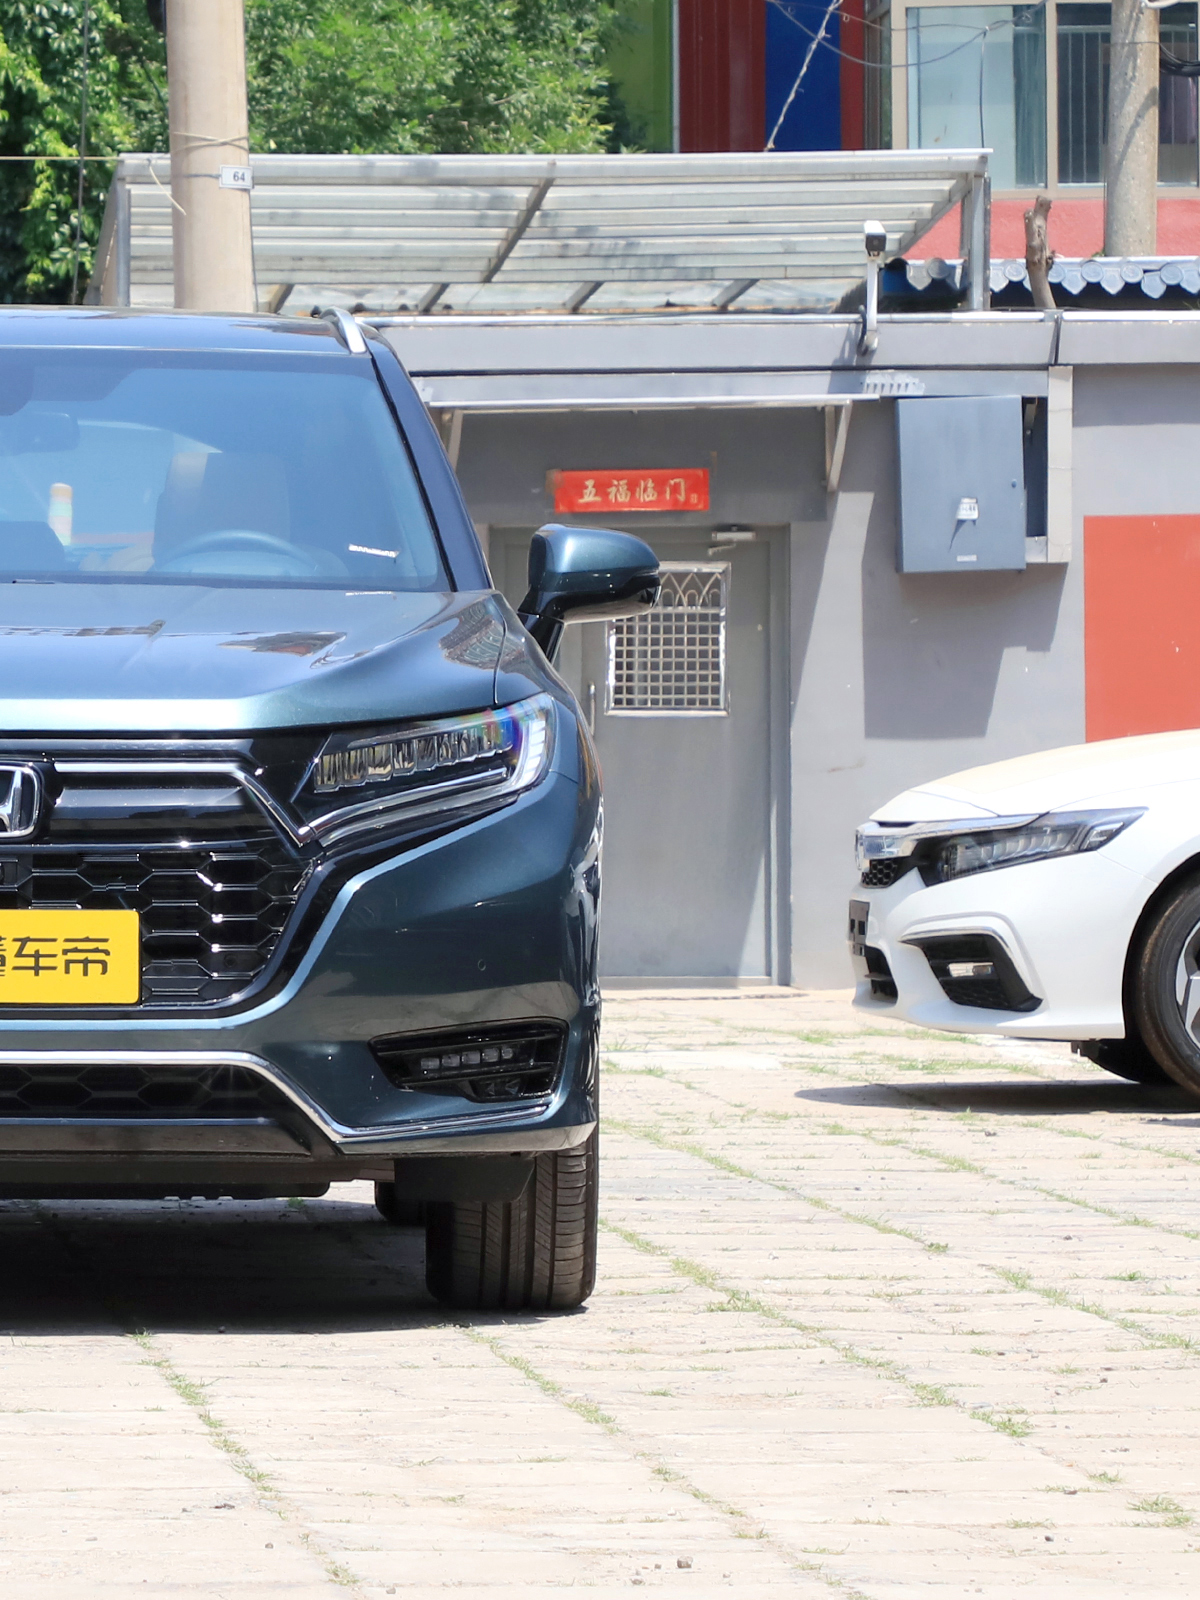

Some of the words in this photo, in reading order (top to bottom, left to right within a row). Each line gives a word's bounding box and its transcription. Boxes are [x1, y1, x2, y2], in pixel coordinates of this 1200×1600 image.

[232, 171, 246, 182] 64
[578, 477, 686, 504] 五福临门
